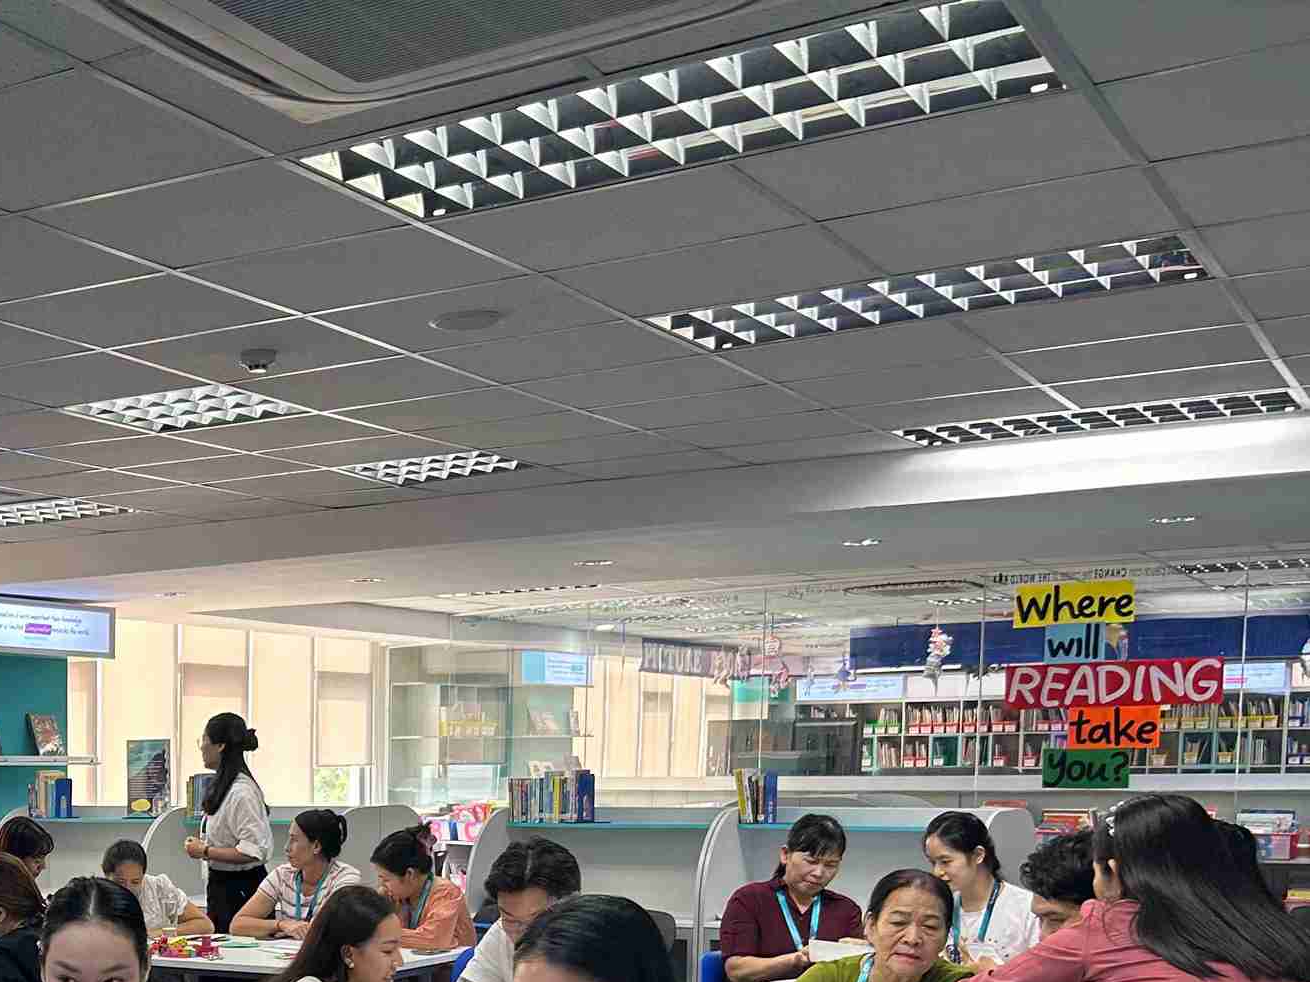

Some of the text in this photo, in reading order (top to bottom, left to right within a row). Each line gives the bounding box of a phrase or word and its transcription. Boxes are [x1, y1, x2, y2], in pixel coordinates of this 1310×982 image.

[1016, 585, 1133, 623] Where
[1047, 624, 1099, 658] will
[1007, 658, 1221, 707] READING
[1069, 706, 1157, 746] take
